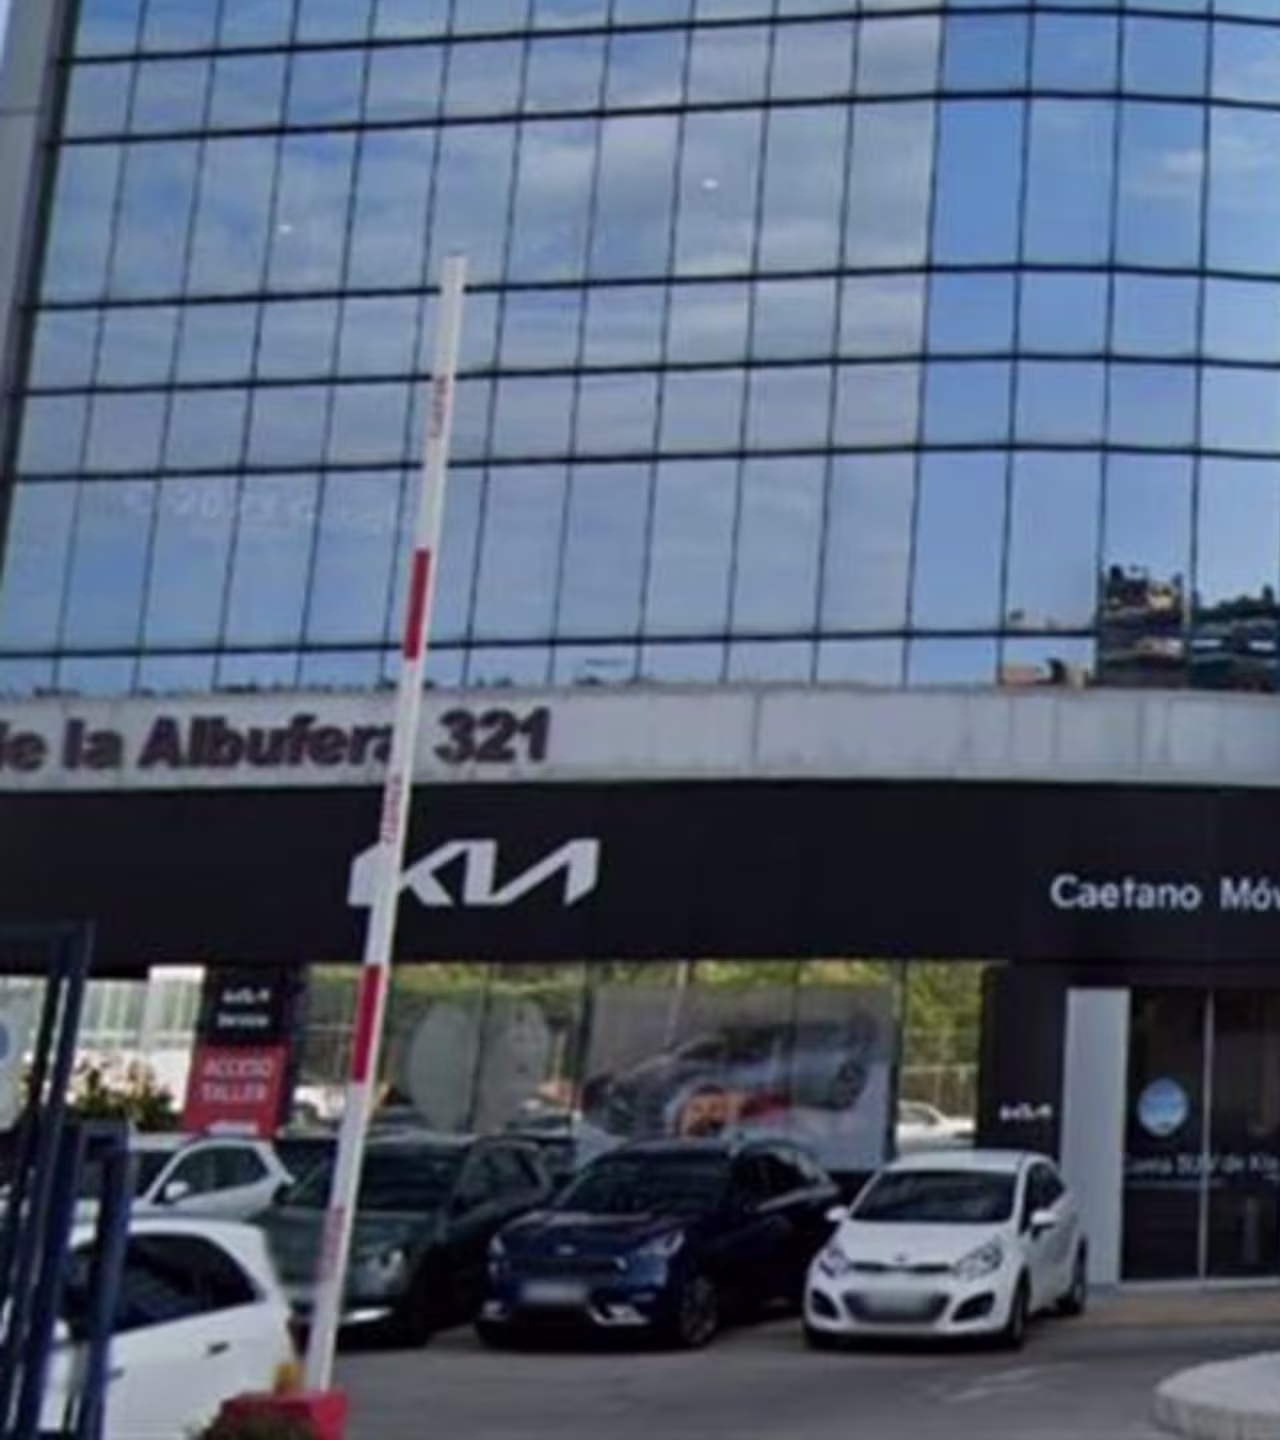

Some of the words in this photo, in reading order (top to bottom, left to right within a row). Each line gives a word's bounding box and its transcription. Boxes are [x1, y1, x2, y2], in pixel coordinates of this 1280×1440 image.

[62, 718, 124, 771] la
[434, 708, 551, 762] 321
[347, 838, 599, 906] KIA
[1050, 873, 1202, 909] Caetano
[203, 1057, 273, 1078] ACCESO
[201, 1080, 267, 1102] TALLER
